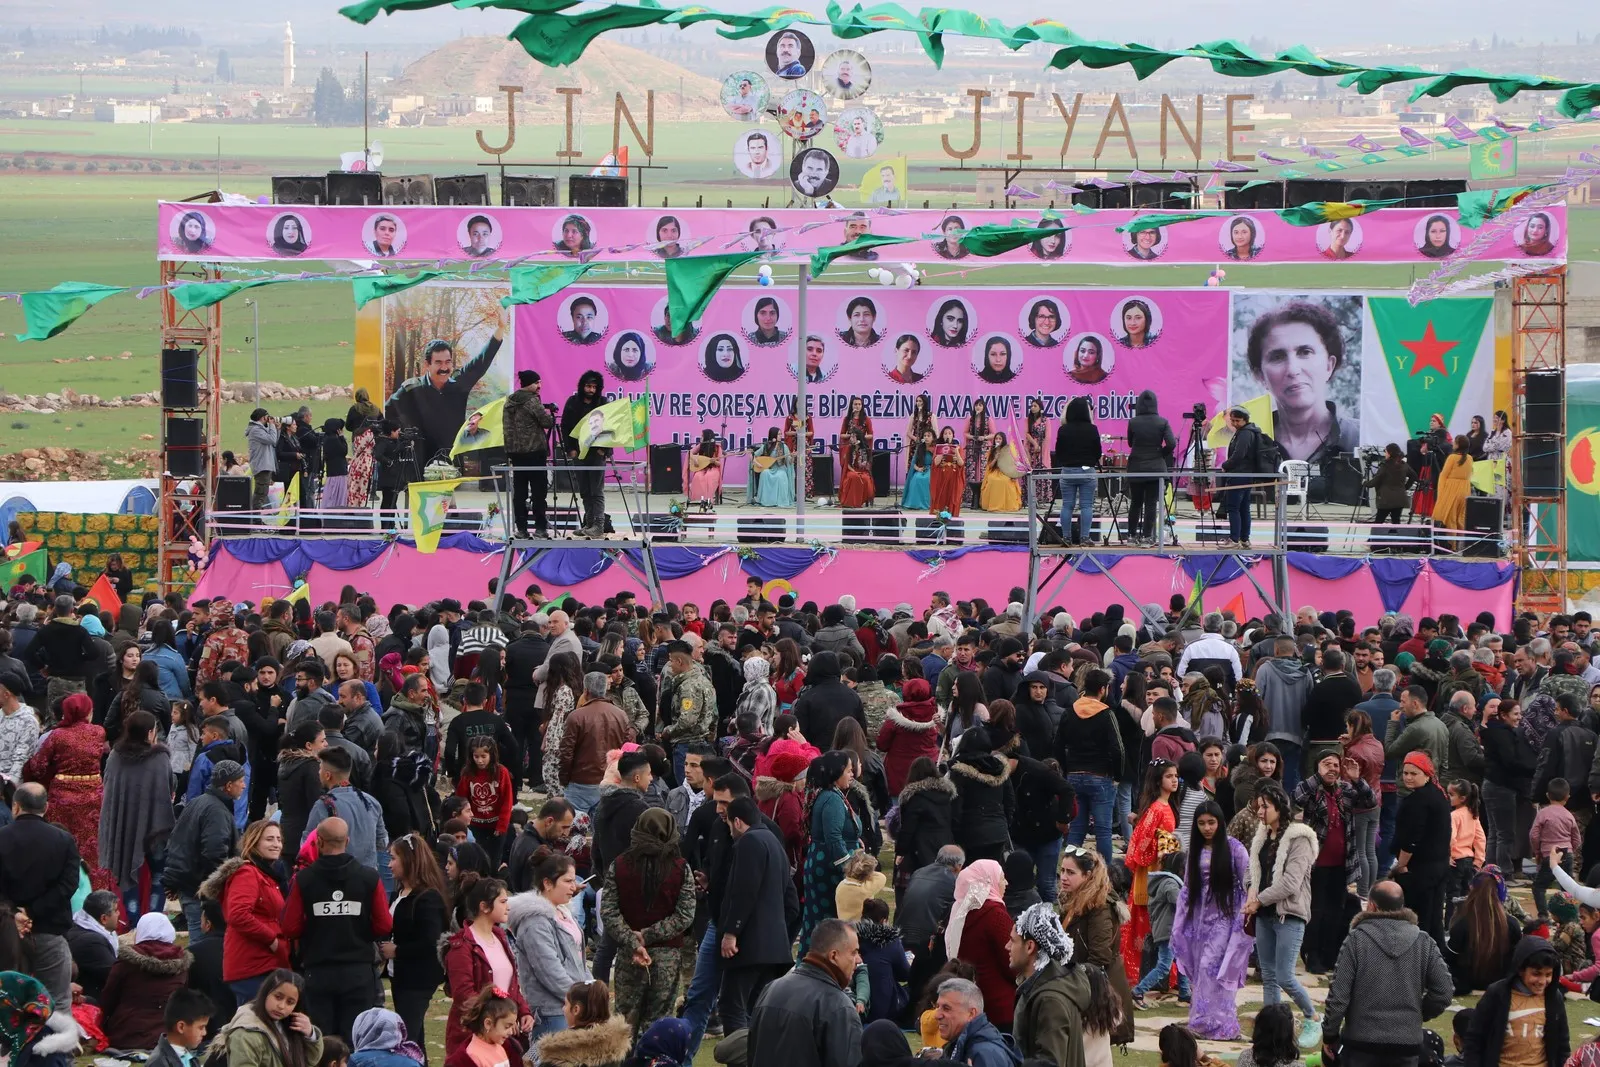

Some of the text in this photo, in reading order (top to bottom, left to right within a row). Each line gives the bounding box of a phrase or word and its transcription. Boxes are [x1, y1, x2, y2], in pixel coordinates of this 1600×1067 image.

[476, 86, 1256, 161] JIN JIYANE
[670, 393, 692, 416] RE
[696, 393, 768, 423] ŞOREŞA
[818, 389, 914, 417] BİPRÊZİN
[322, 902, 351, 915] 5.11
[1505, 1023, 1545, 1038] AIR
